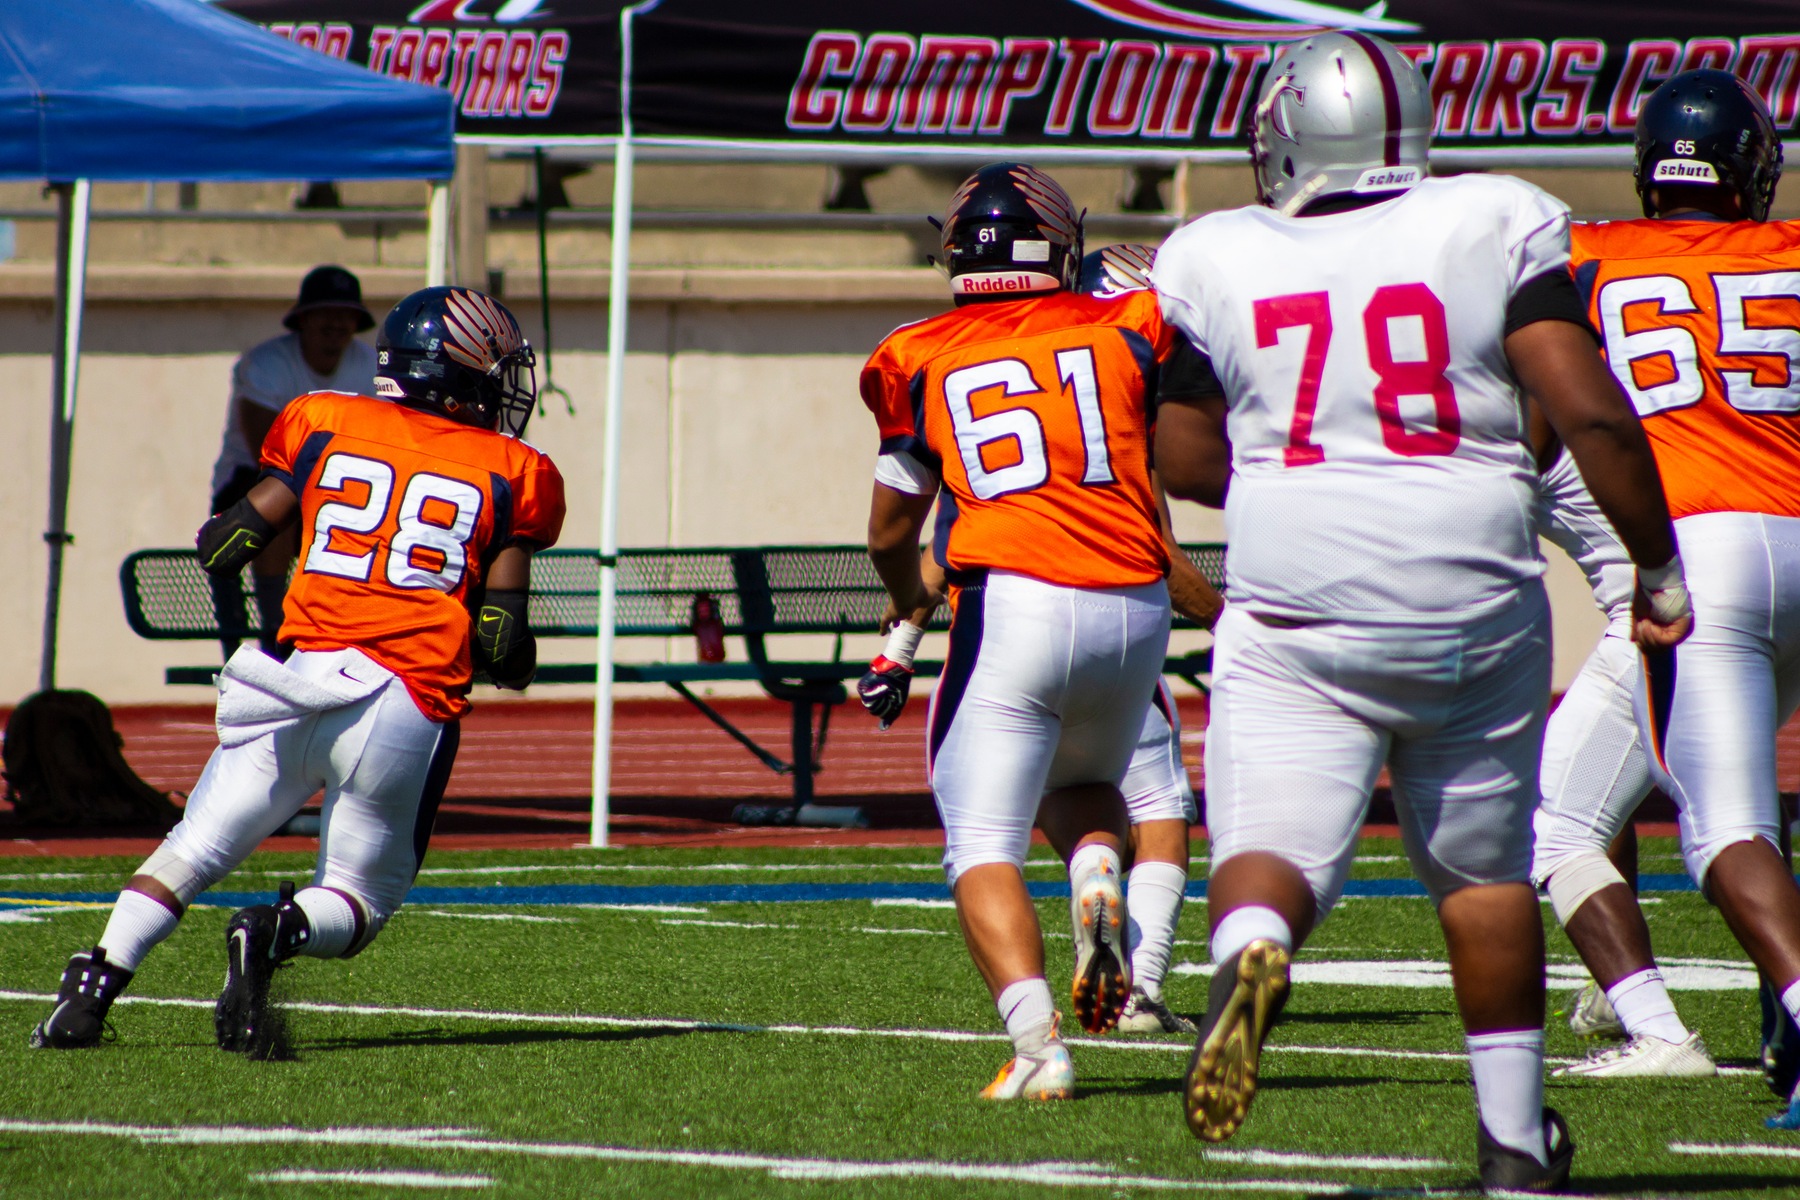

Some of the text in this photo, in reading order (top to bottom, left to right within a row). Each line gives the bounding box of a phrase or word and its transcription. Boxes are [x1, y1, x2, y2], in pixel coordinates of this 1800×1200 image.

[1674, 140, 1696, 155] 65
[1660, 163, 1710, 177] schutt
[1366, 171, 1416, 186] schutt
[979, 227, 997, 243] 61
[962, 275, 1031, 292] Riddell
[1600, 269, 1800, 418] 65
[379, 351, 389, 365] 28
[1252, 282, 1461, 467] 78
[944, 345, 1118, 500] 61
[304, 451, 483, 596] 28
